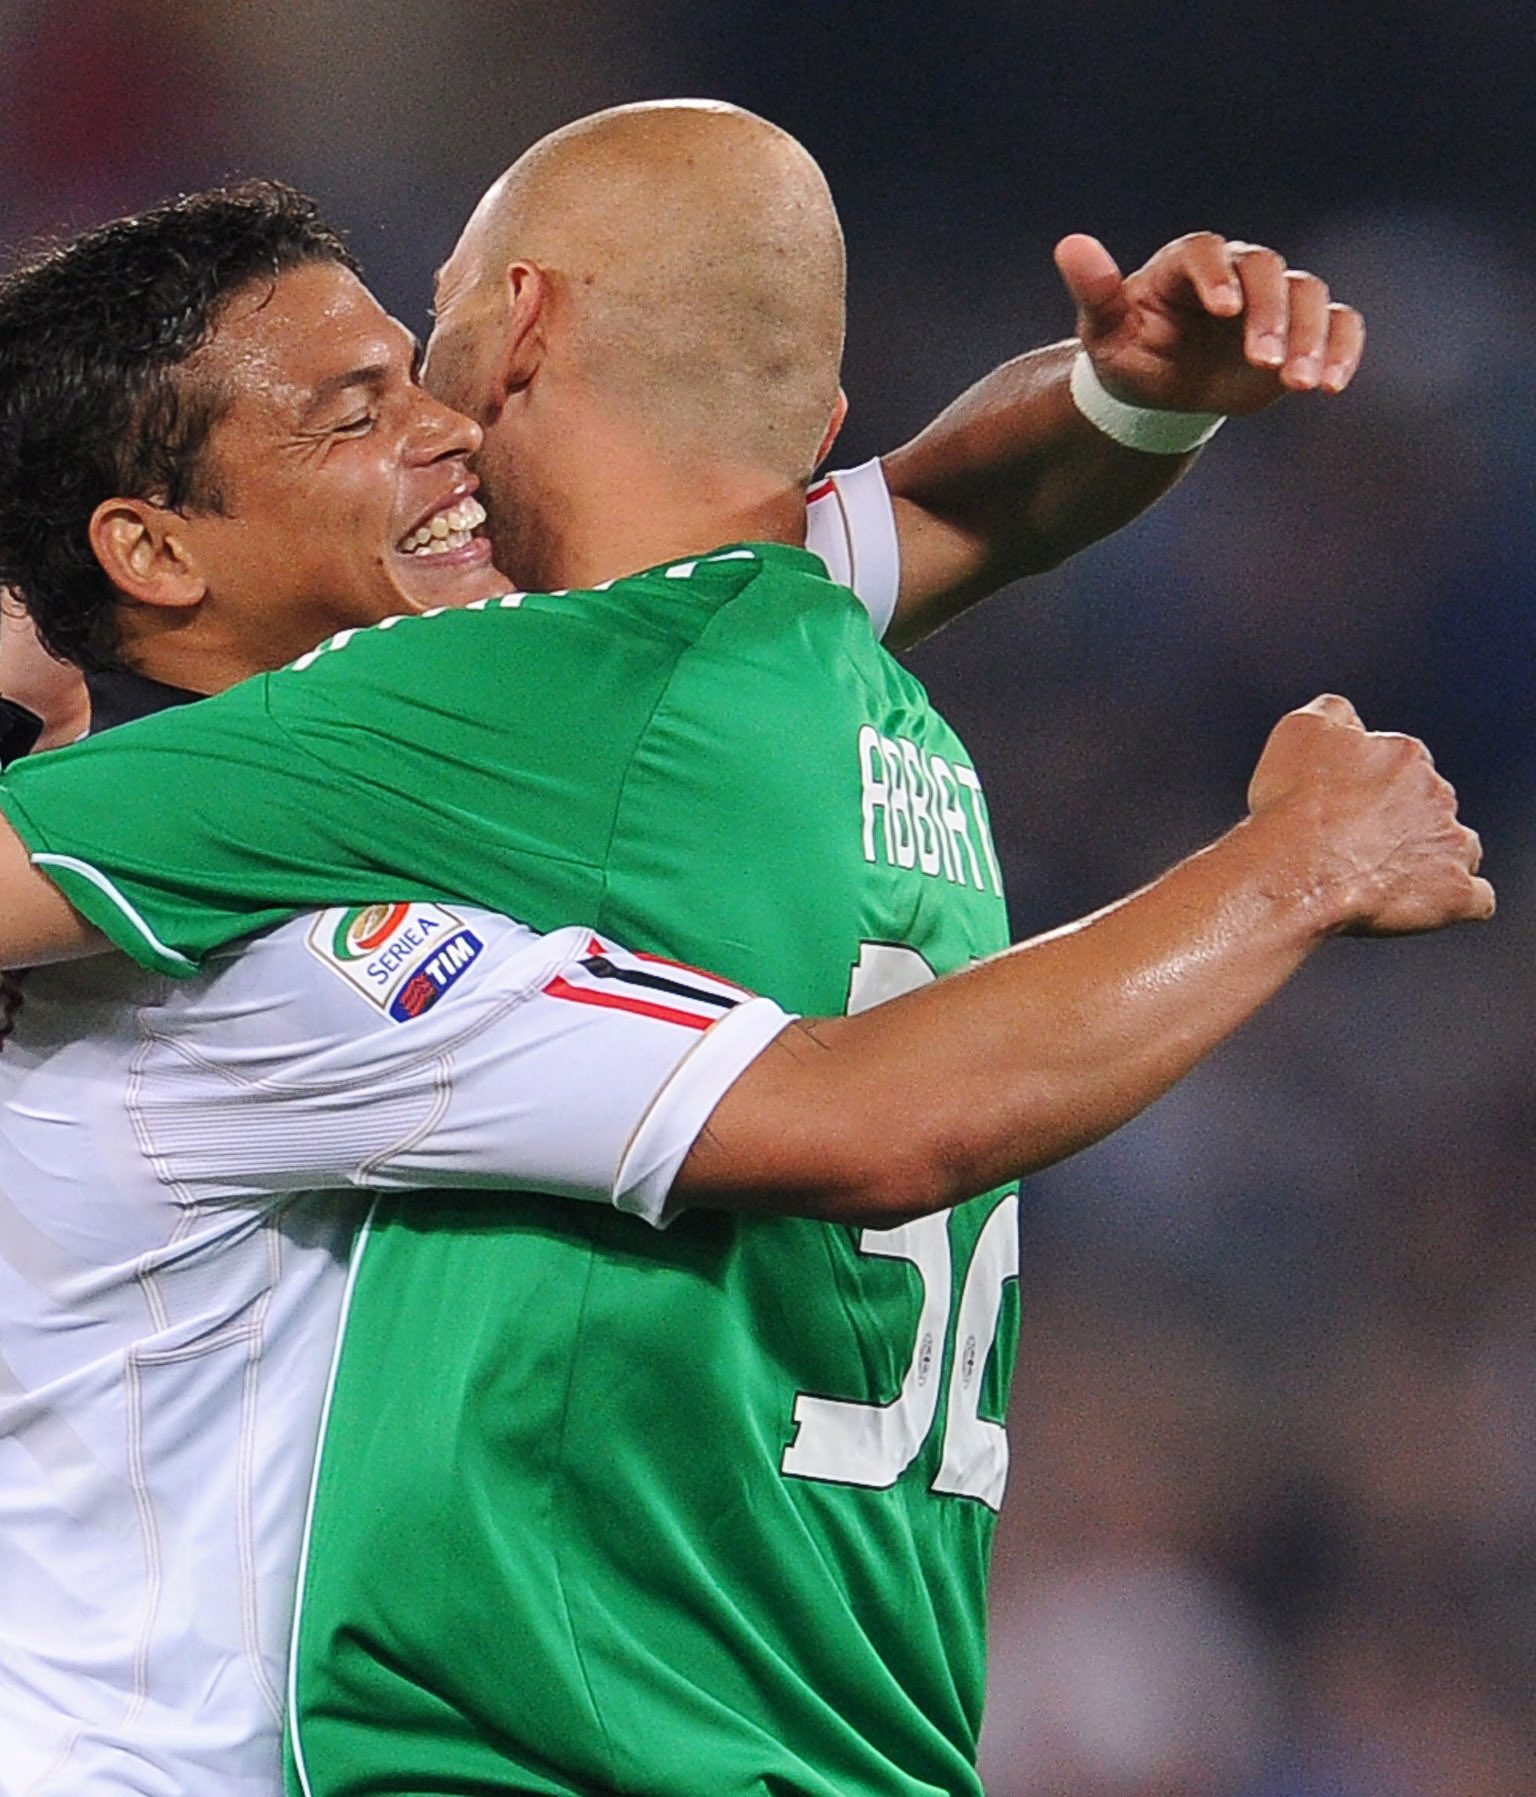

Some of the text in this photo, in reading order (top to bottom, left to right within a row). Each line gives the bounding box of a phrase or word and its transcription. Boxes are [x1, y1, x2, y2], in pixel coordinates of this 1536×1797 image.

[367, 917, 440, 985] SERIE A
[424, 936, 476, 985] TIM
